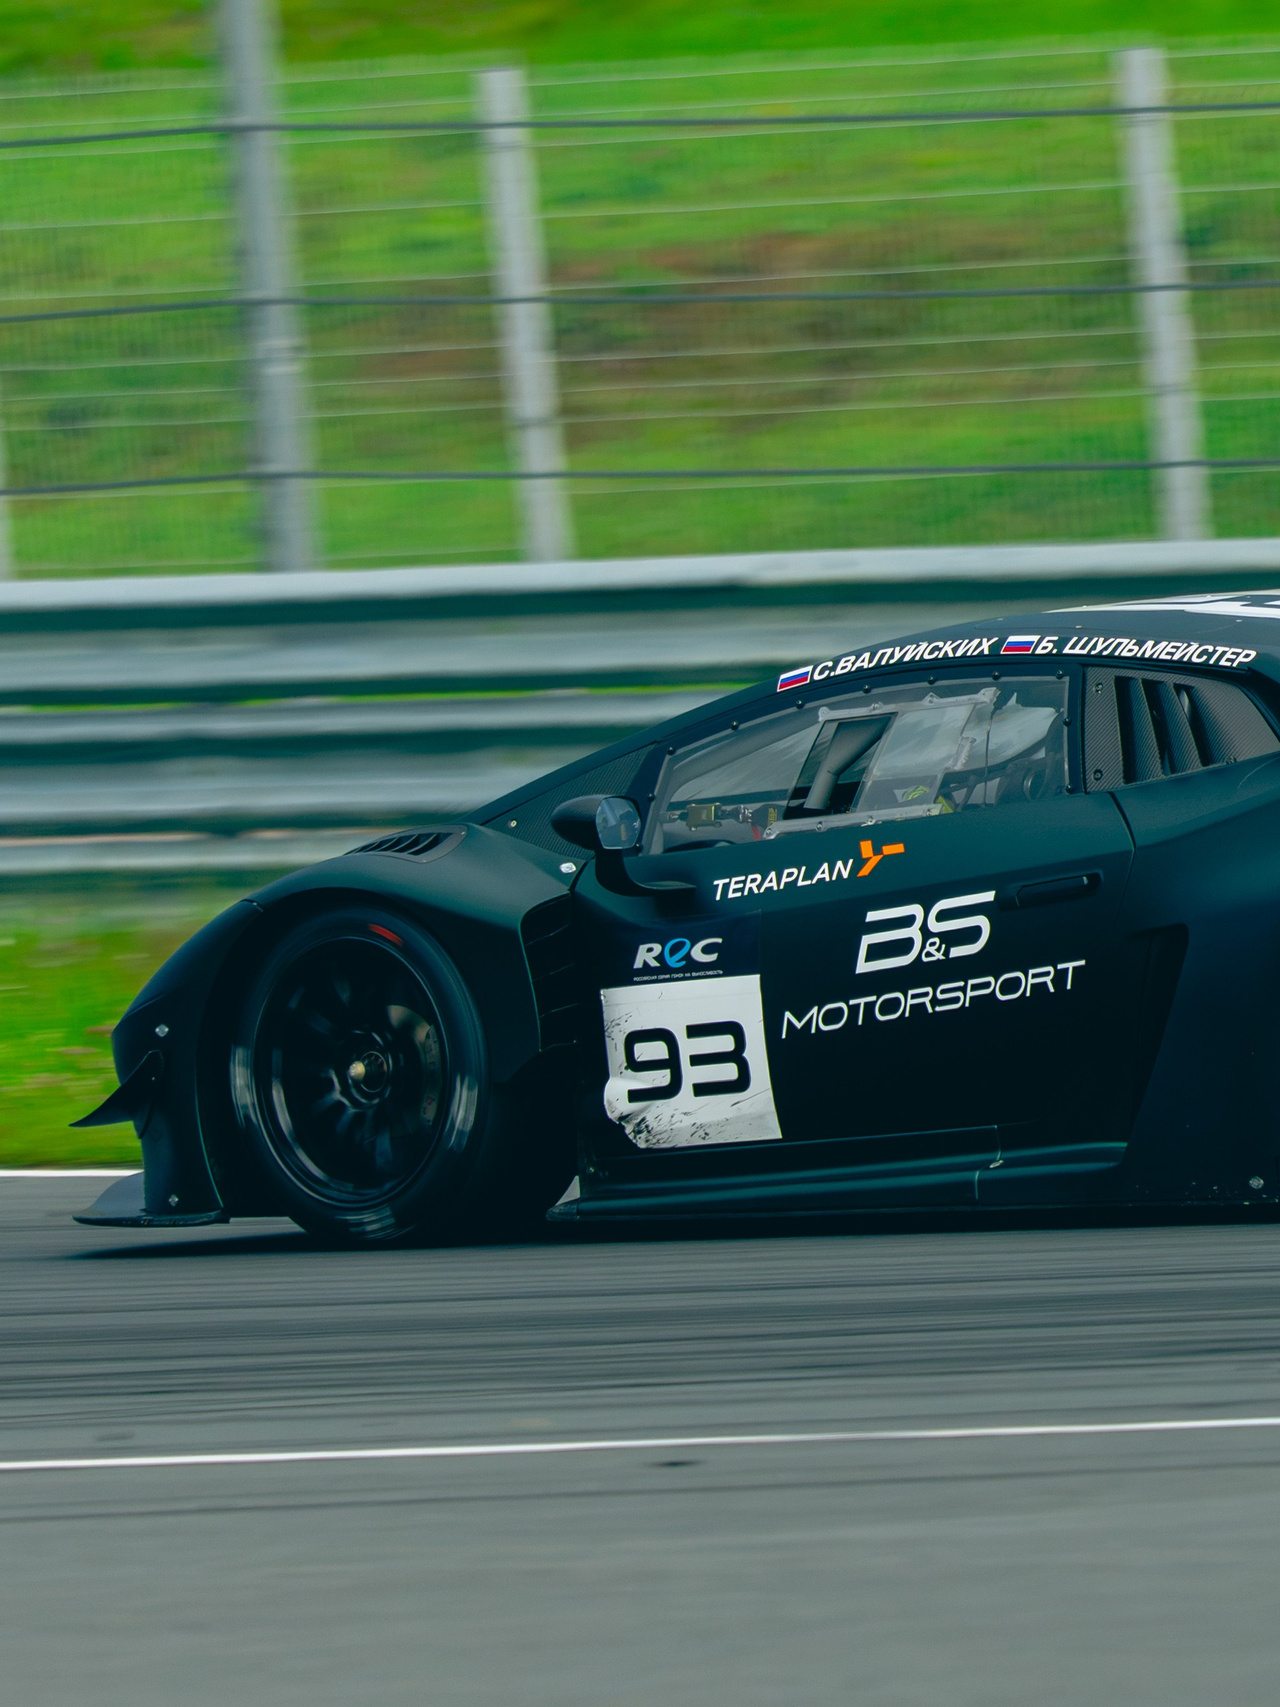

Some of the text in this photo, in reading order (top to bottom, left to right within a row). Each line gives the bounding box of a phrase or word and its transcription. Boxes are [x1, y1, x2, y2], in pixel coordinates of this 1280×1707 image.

[1035, 636, 1257, 668] Б. ШУЛЬМЕЙСТЕР
[712, 859, 853, 901] TERAPLAN
[855, 890, 996, 974] B&S
[782, 960, 1086, 1039] MOTORSPORT
[623, 1020, 752, 1104] 93
